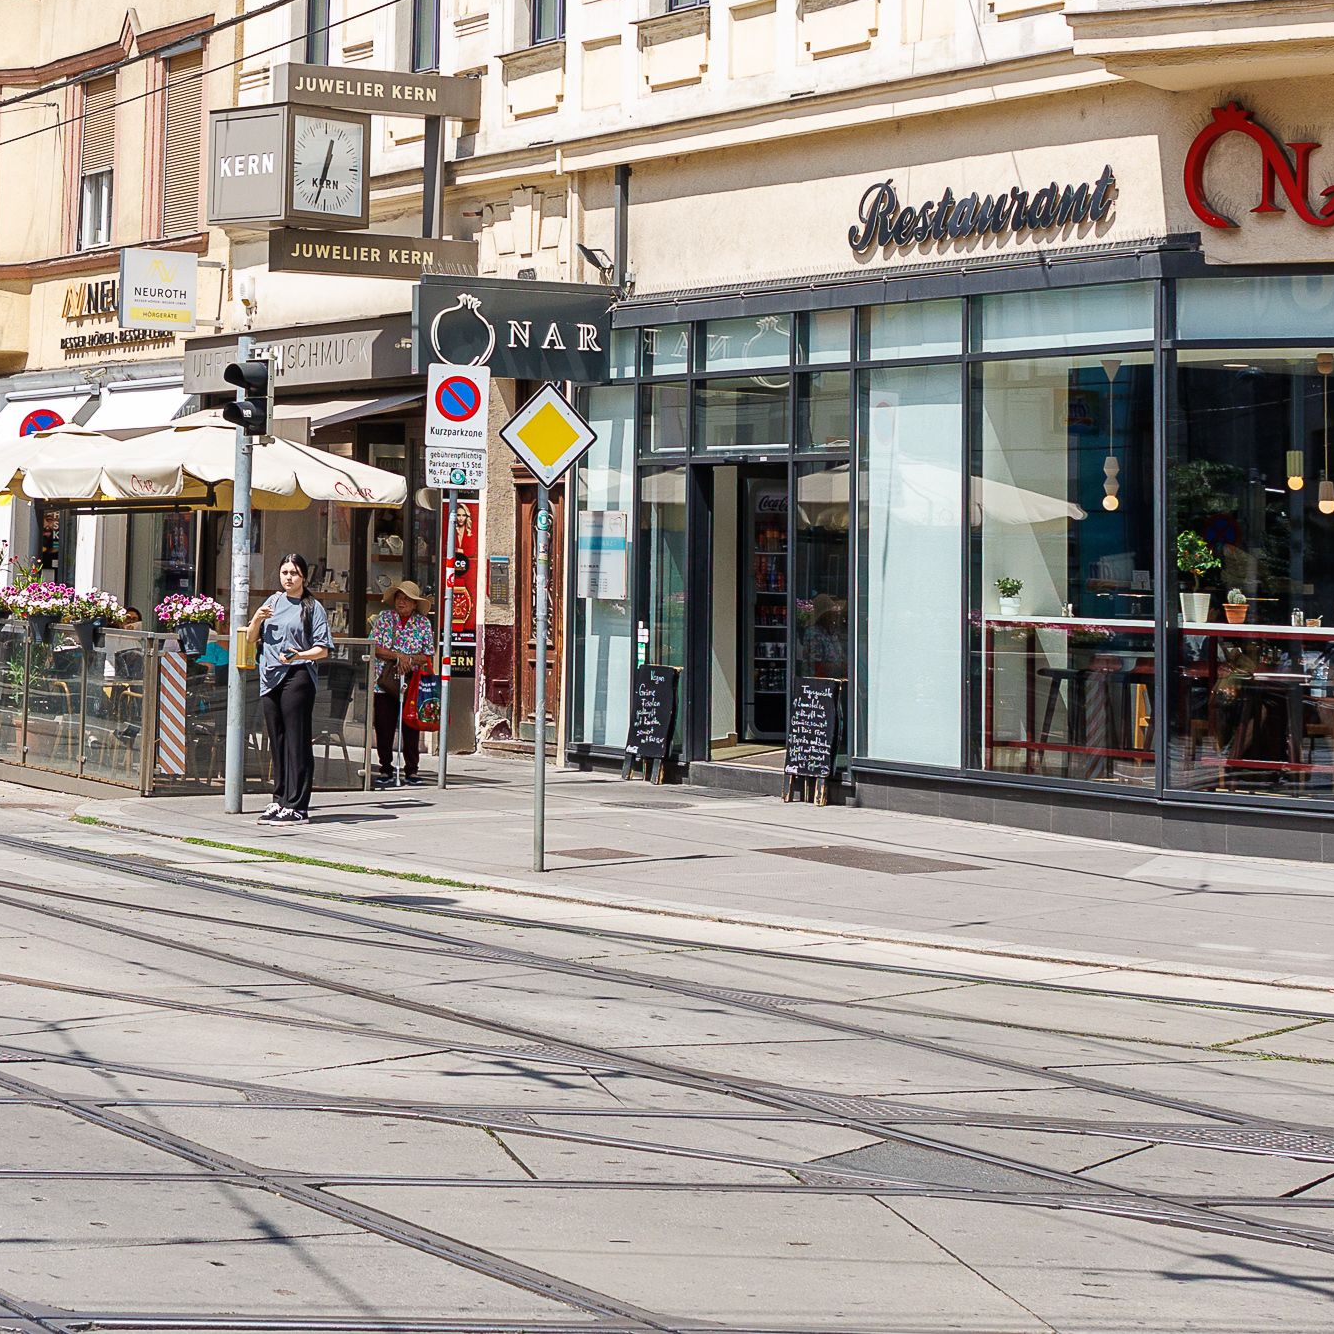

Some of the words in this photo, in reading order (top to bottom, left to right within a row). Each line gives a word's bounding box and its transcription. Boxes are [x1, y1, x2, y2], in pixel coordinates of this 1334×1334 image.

[294, 75, 385, 99] JUWELIER
[391, 84, 438, 103] KERN
[219, 152, 275, 178] KERN
[311, 176, 340, 191] KERN
[849, 164, 1114, 253] Restaurant
[290, 242, 382, 263] JUWELIER
[388, 248, 435, 266] KERN
[134, 286, 187, 300] NEUROTH
[142, 310, 178, 320] HÖRGERÄTE
[287, 336, 369, 370] SCHMUCK
[430, 426, 483, 438] Kurzparkzone
[430, 450, 483, 461] gebührenpflichtig
[429, 459, 460, 468] Parkdauer:
[471, 461, 483, 469] Std.
[454, 559, 467, 568] ce
[450, 656, 474, 666] ERN
